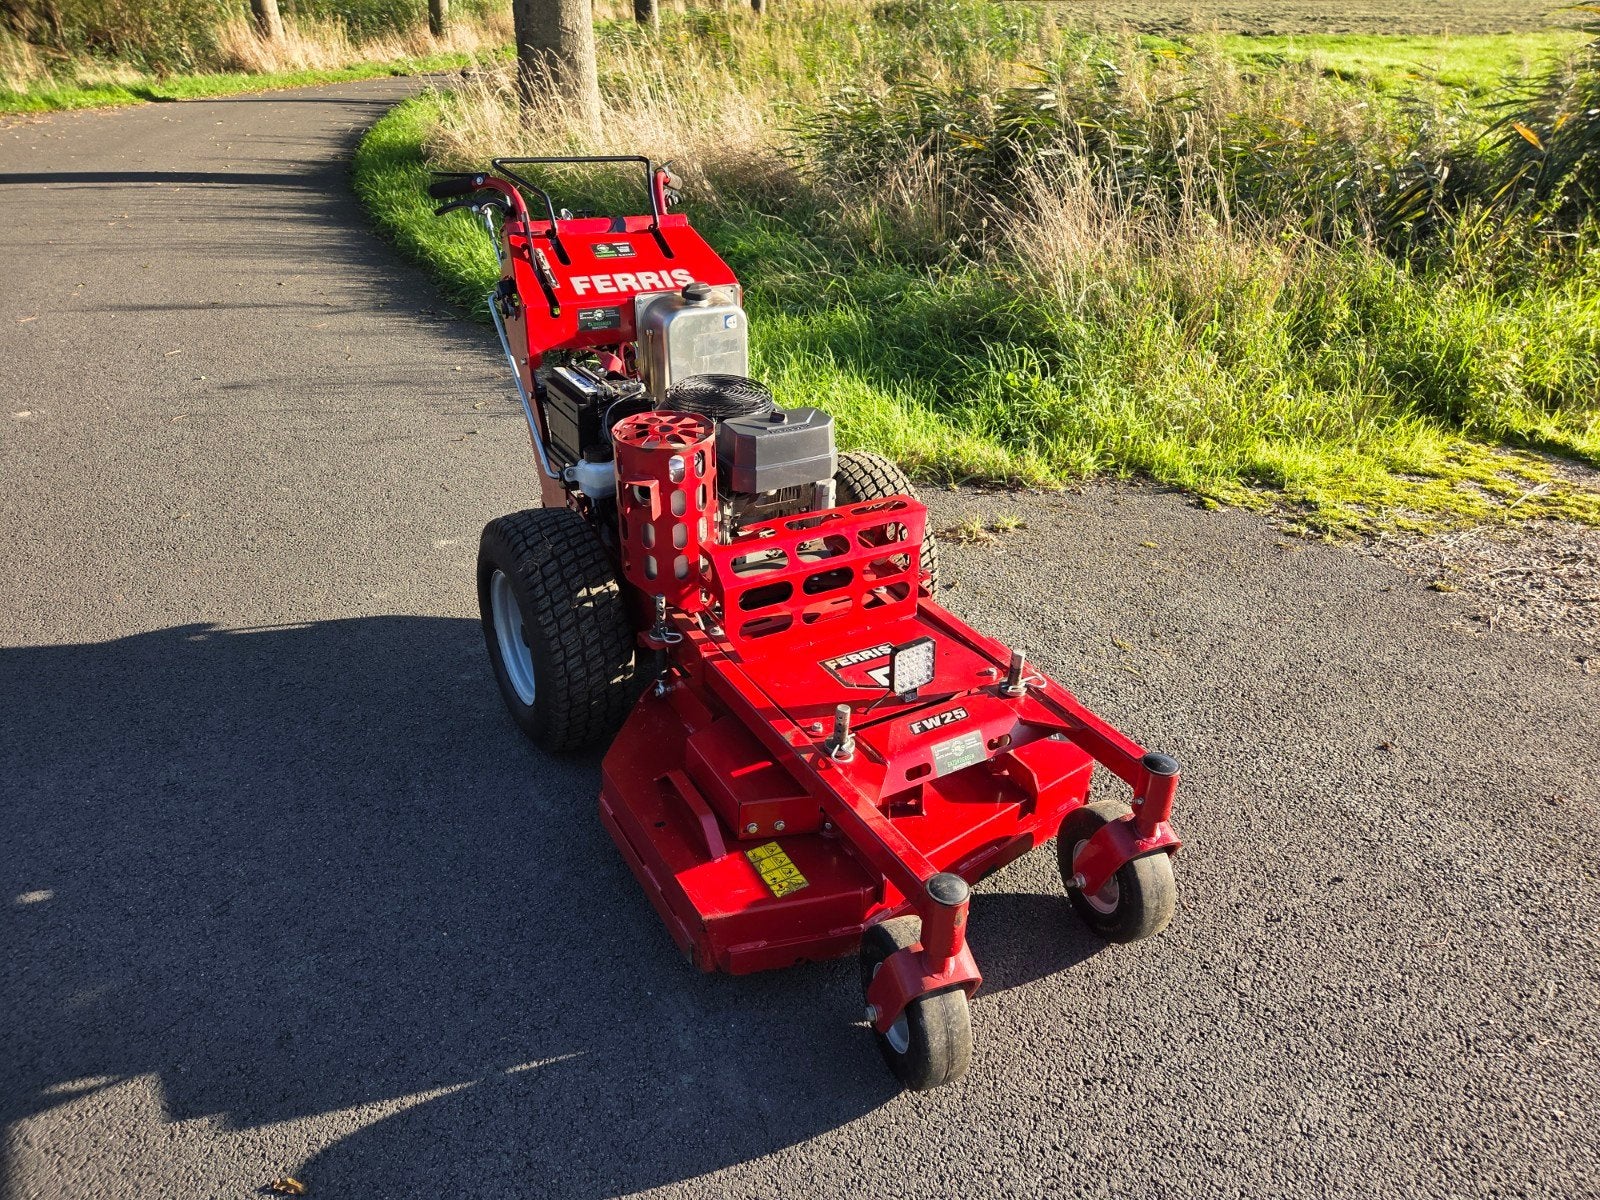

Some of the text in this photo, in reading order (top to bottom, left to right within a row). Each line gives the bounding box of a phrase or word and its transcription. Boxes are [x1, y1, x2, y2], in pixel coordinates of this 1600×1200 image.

[569, 269, 695, 295] FERRIS
[825, 644, 892, 670] FERRIS
[910, 707, 967, 735] FW25
